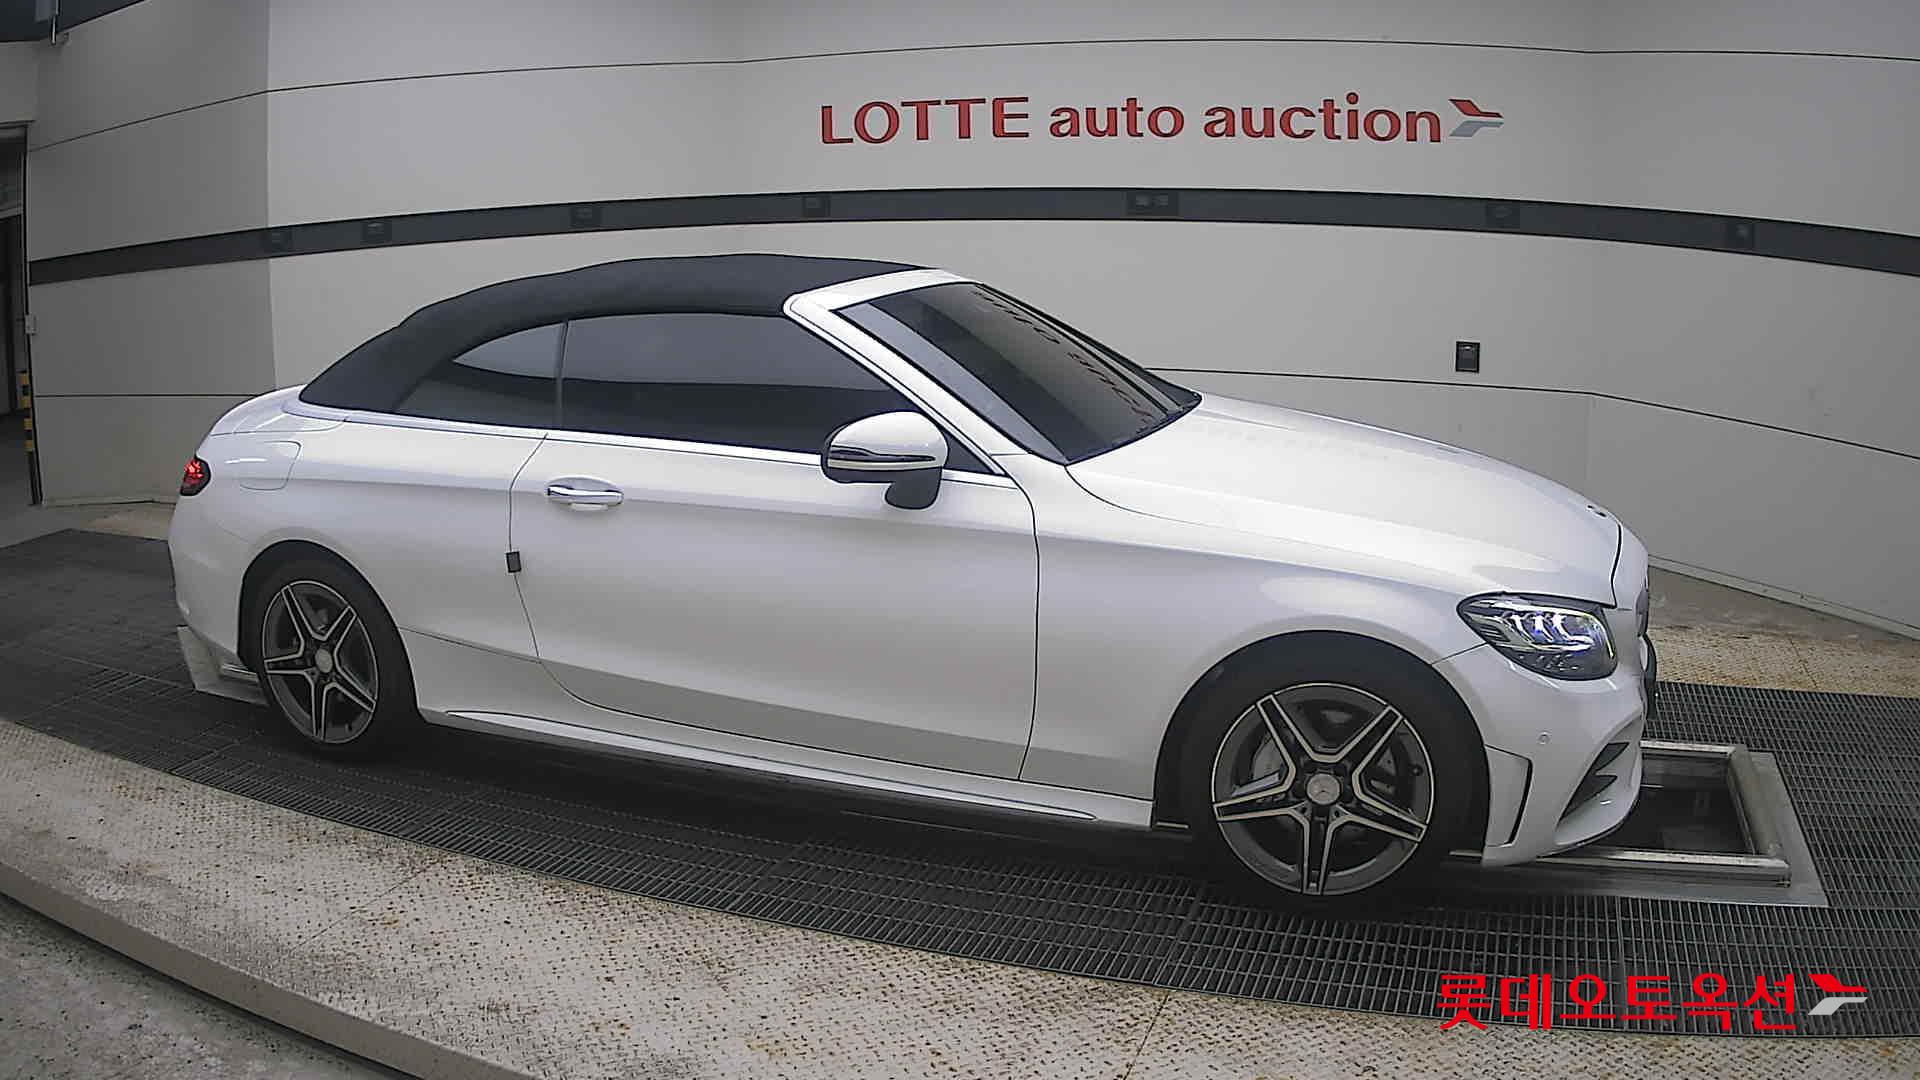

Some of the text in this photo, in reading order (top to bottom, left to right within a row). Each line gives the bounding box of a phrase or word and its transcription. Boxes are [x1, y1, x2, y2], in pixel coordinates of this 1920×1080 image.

[820, 93, 1442, 144] LOTTE auto auction
